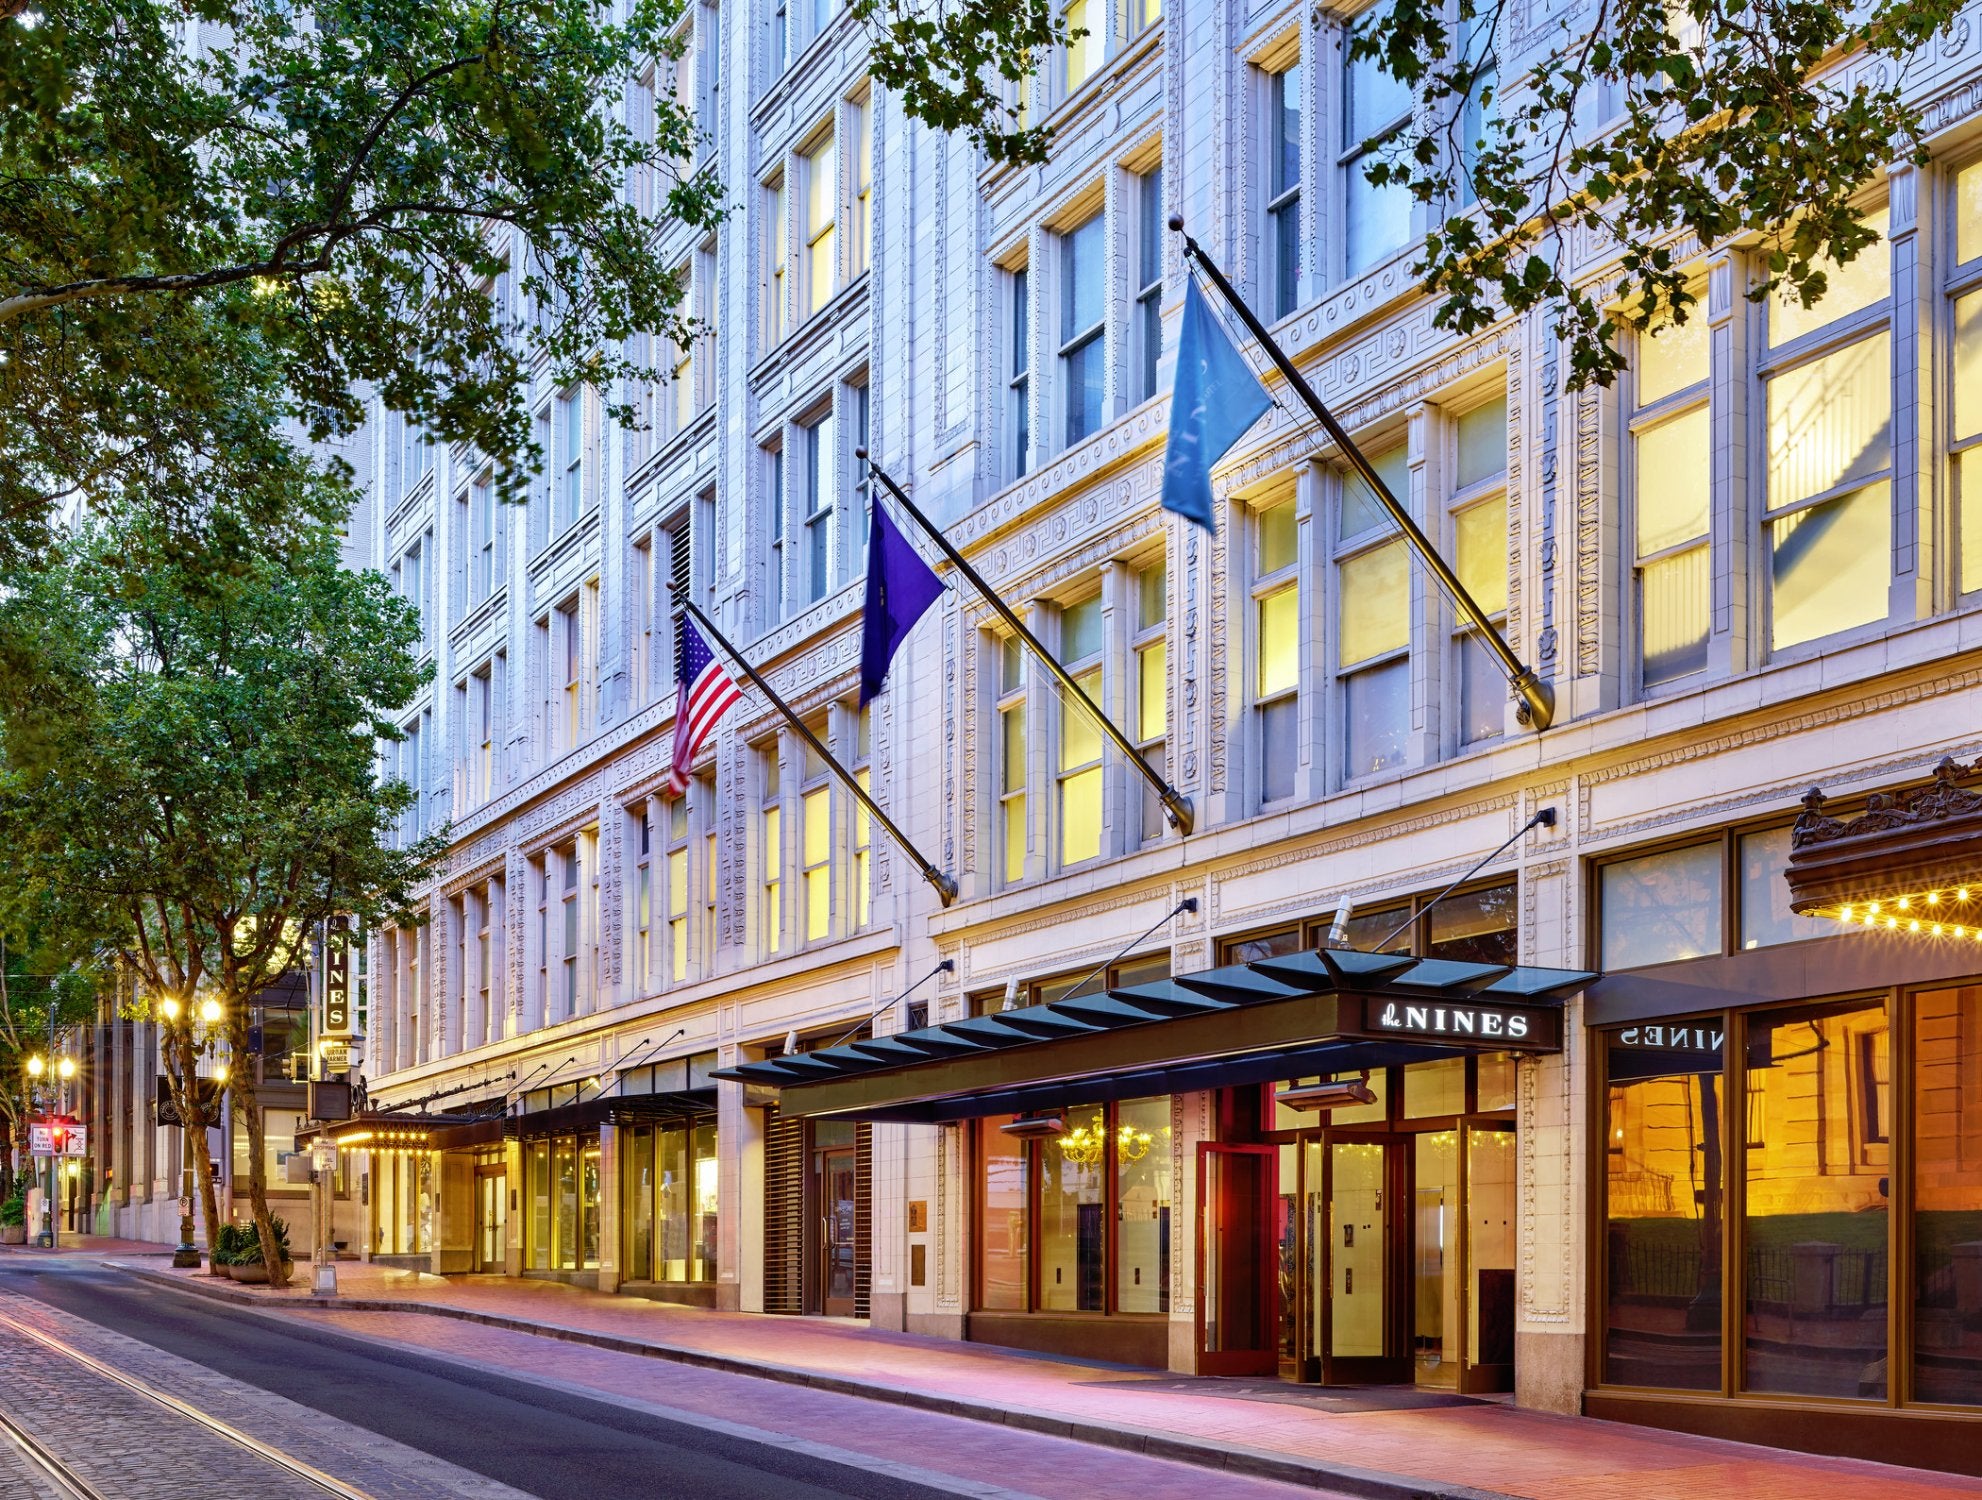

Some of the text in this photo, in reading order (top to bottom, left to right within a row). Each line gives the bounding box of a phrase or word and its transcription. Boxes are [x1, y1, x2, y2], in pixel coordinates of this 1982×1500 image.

[329, 933, 345, 1024] NINES
[1382, 1003, 1528, 1037] the NINES
